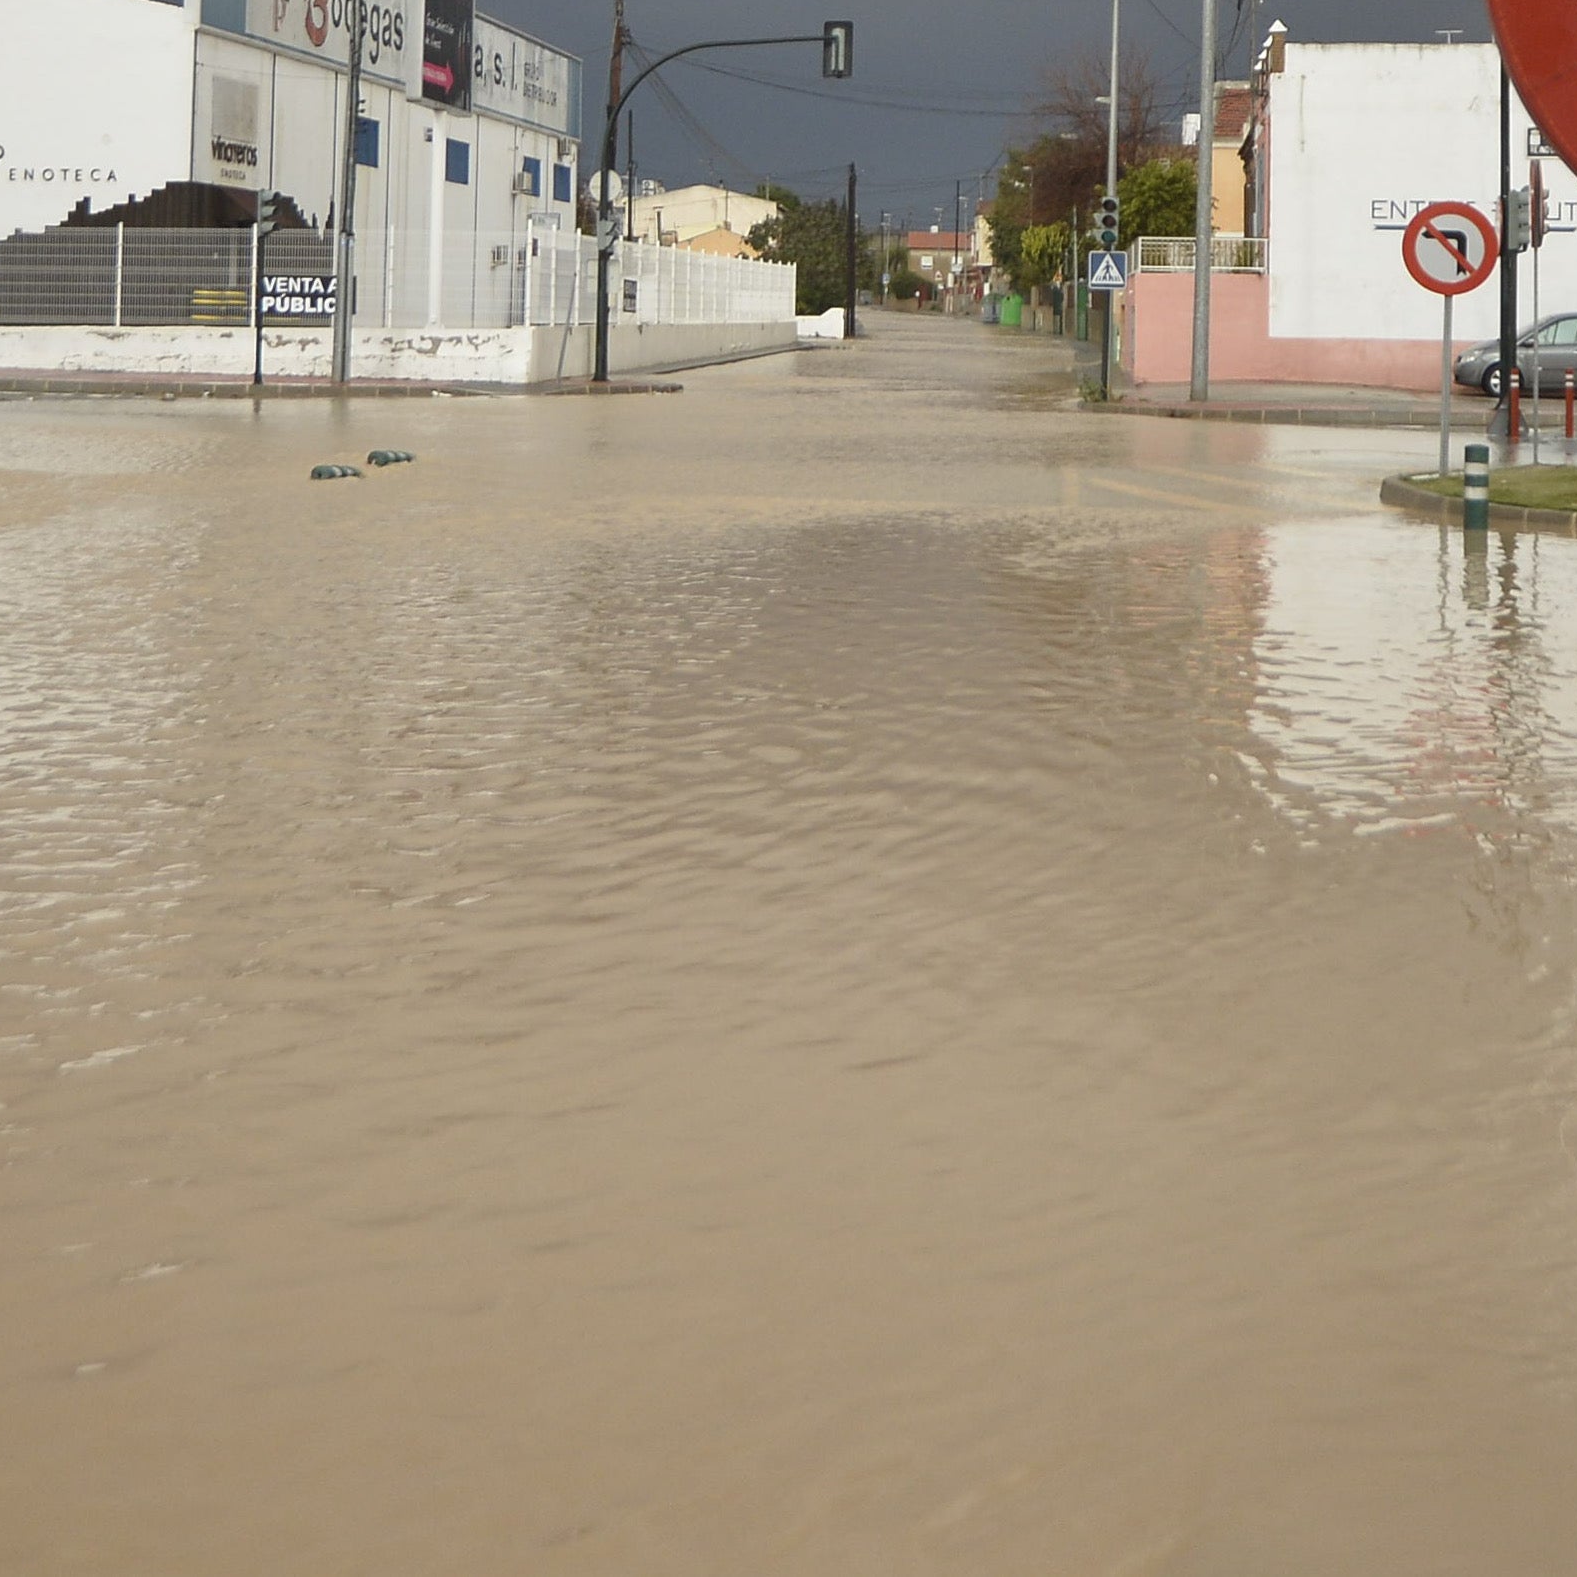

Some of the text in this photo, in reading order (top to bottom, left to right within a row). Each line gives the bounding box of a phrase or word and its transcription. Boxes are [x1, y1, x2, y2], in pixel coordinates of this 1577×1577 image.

[9, 167, 118, 182] ENOTECA
[263, 276, 338, 294] VENTA A
[261, 294, 336, 313] PÚBLIC
